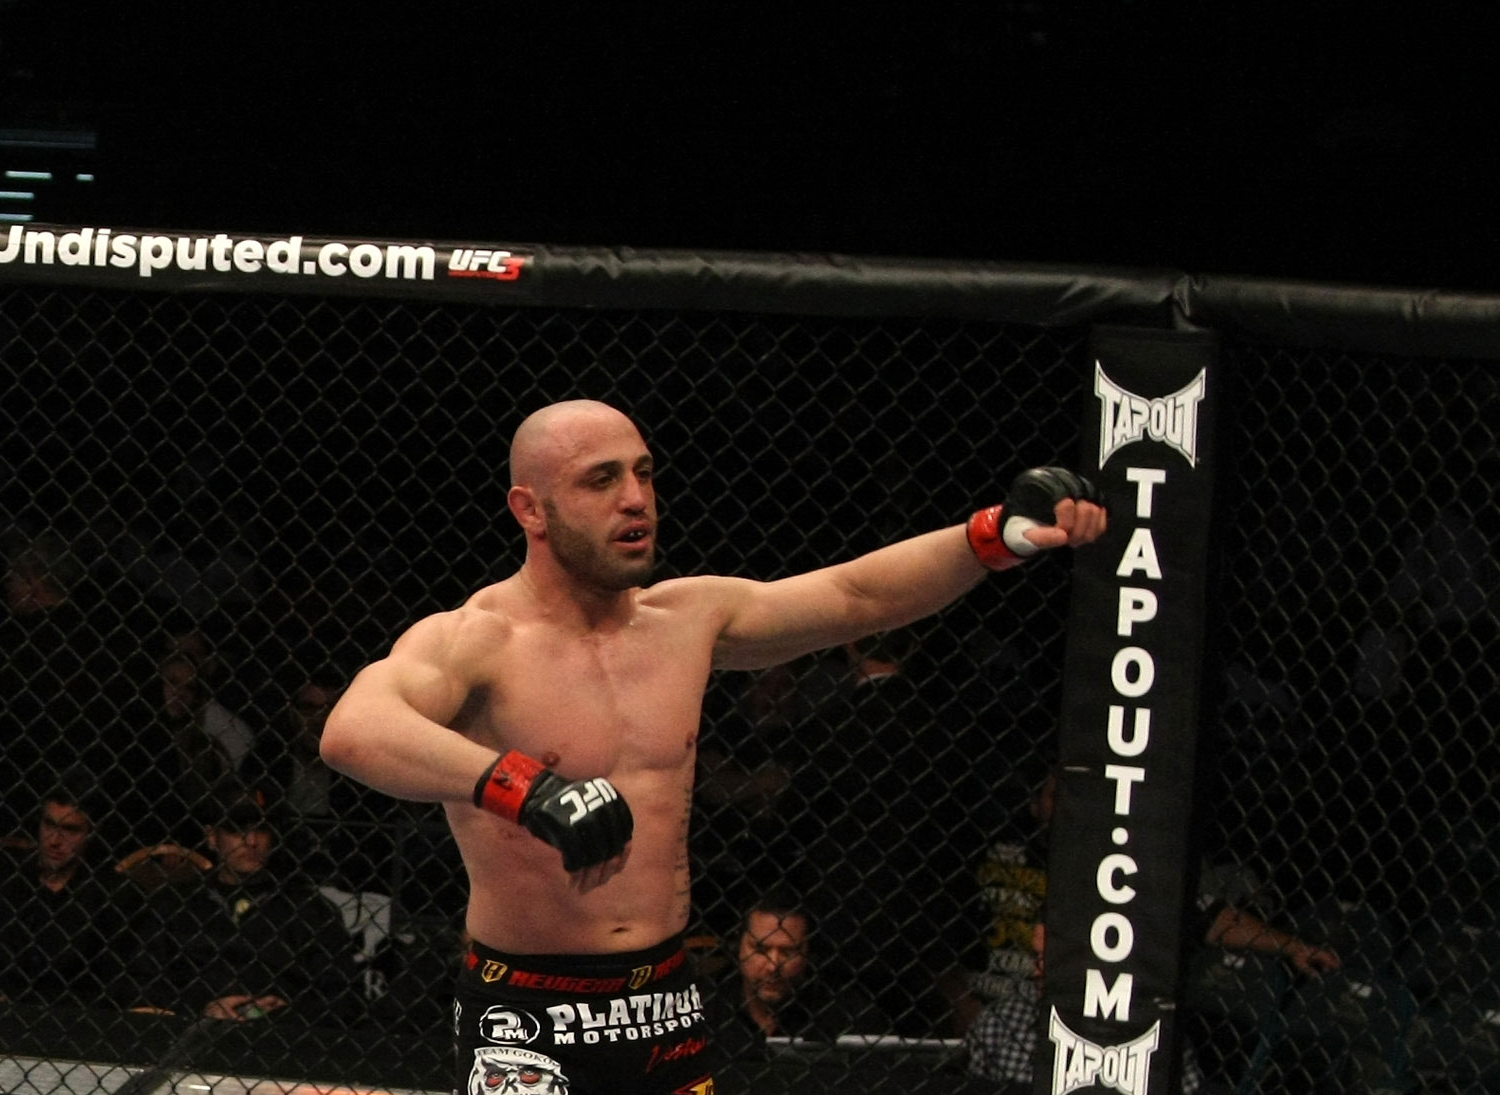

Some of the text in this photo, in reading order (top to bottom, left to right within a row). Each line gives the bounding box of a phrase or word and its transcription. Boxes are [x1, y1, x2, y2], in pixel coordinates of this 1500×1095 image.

[1094, 359, 1206, 470] TAPOUT
[1083, 466, 1167, 1022] TAPOUT.COM
[559, 777, 618, 826] UFC
